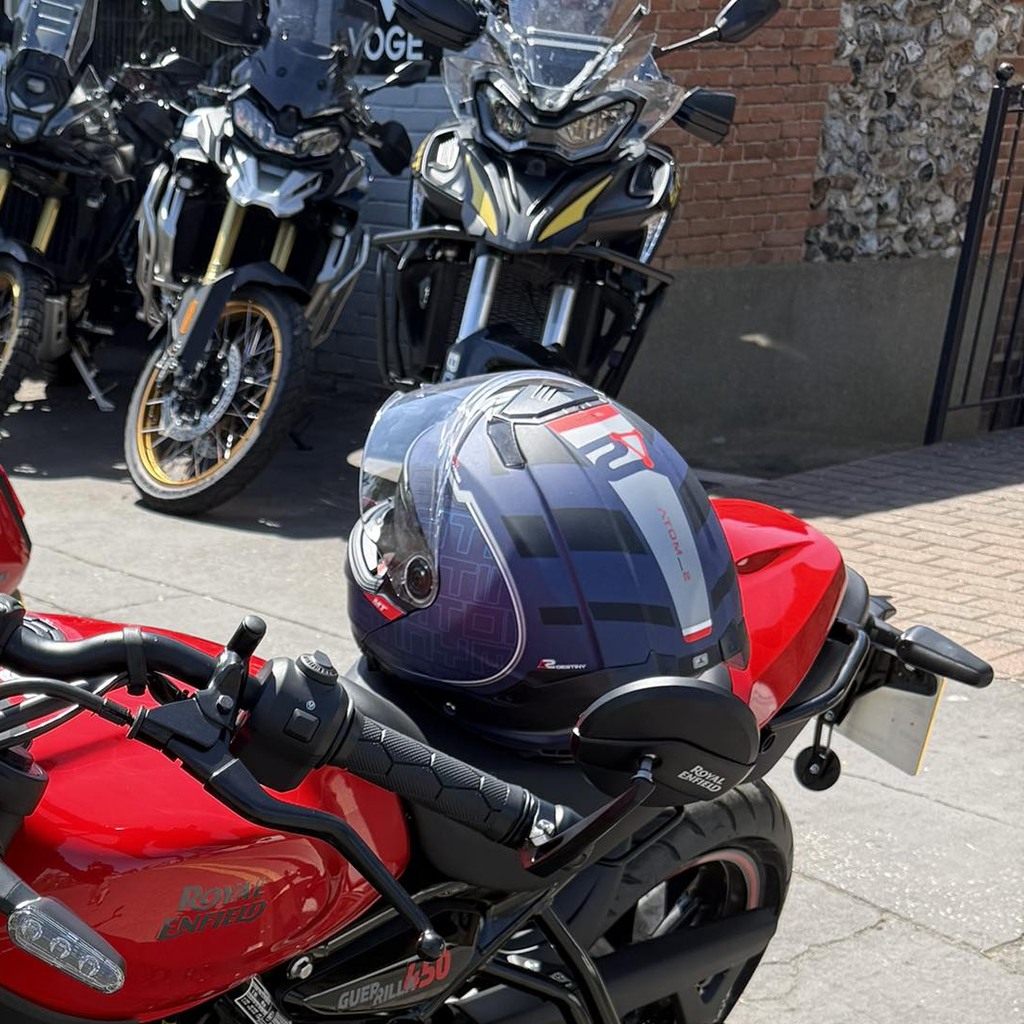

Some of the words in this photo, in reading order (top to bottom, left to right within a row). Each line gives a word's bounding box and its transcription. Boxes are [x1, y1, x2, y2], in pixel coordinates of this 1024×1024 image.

[347, 23, 424, 61] VOGE
[371, 597, 389, 612] MT
[677, 770, 722, 792] ENFIELD
[689, 765, 726, 785] ROYAL
[177, 879, 266, 912] ROYAL
[156, 901, 267, 941] ENFIELD
[401, 947, 452, 992] 450
